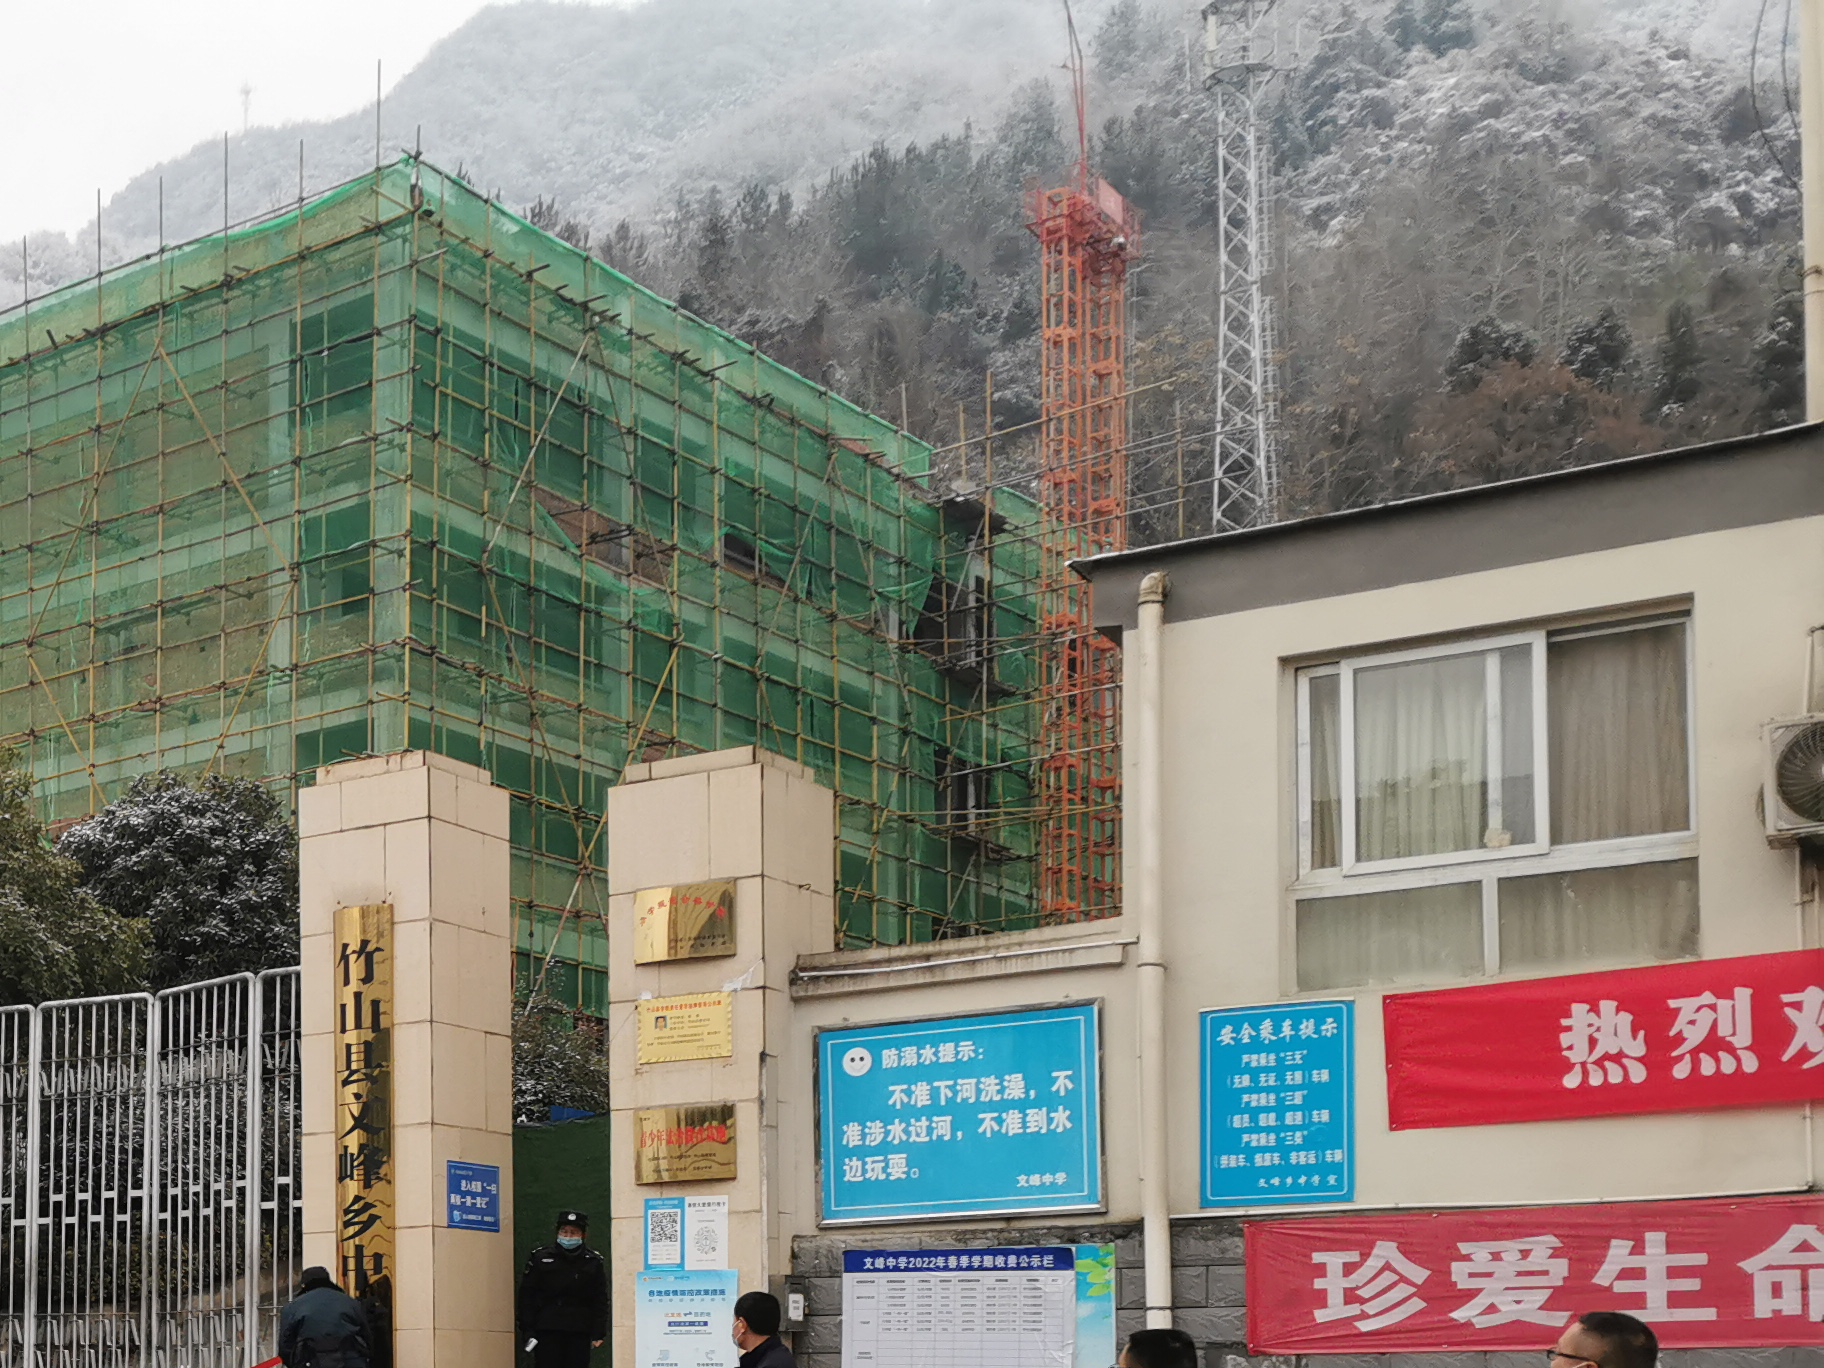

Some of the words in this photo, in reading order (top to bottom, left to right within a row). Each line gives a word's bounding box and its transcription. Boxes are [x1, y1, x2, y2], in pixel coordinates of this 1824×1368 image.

[1216, 1018, 1338, 1046] 安全乘车提示
[841, 1105, 1073, 1148] 准涉水过河，不准到水
[843, 1153, 920, 1183] 边玩耍。
[1016, 1172, 1068, 1188] 文峰中学
[863, 1254, 1055, 1270] 文峰中学2022年春季学期收费公示栏
[1310, 1224, 1824, 1333] 珍爱生命
